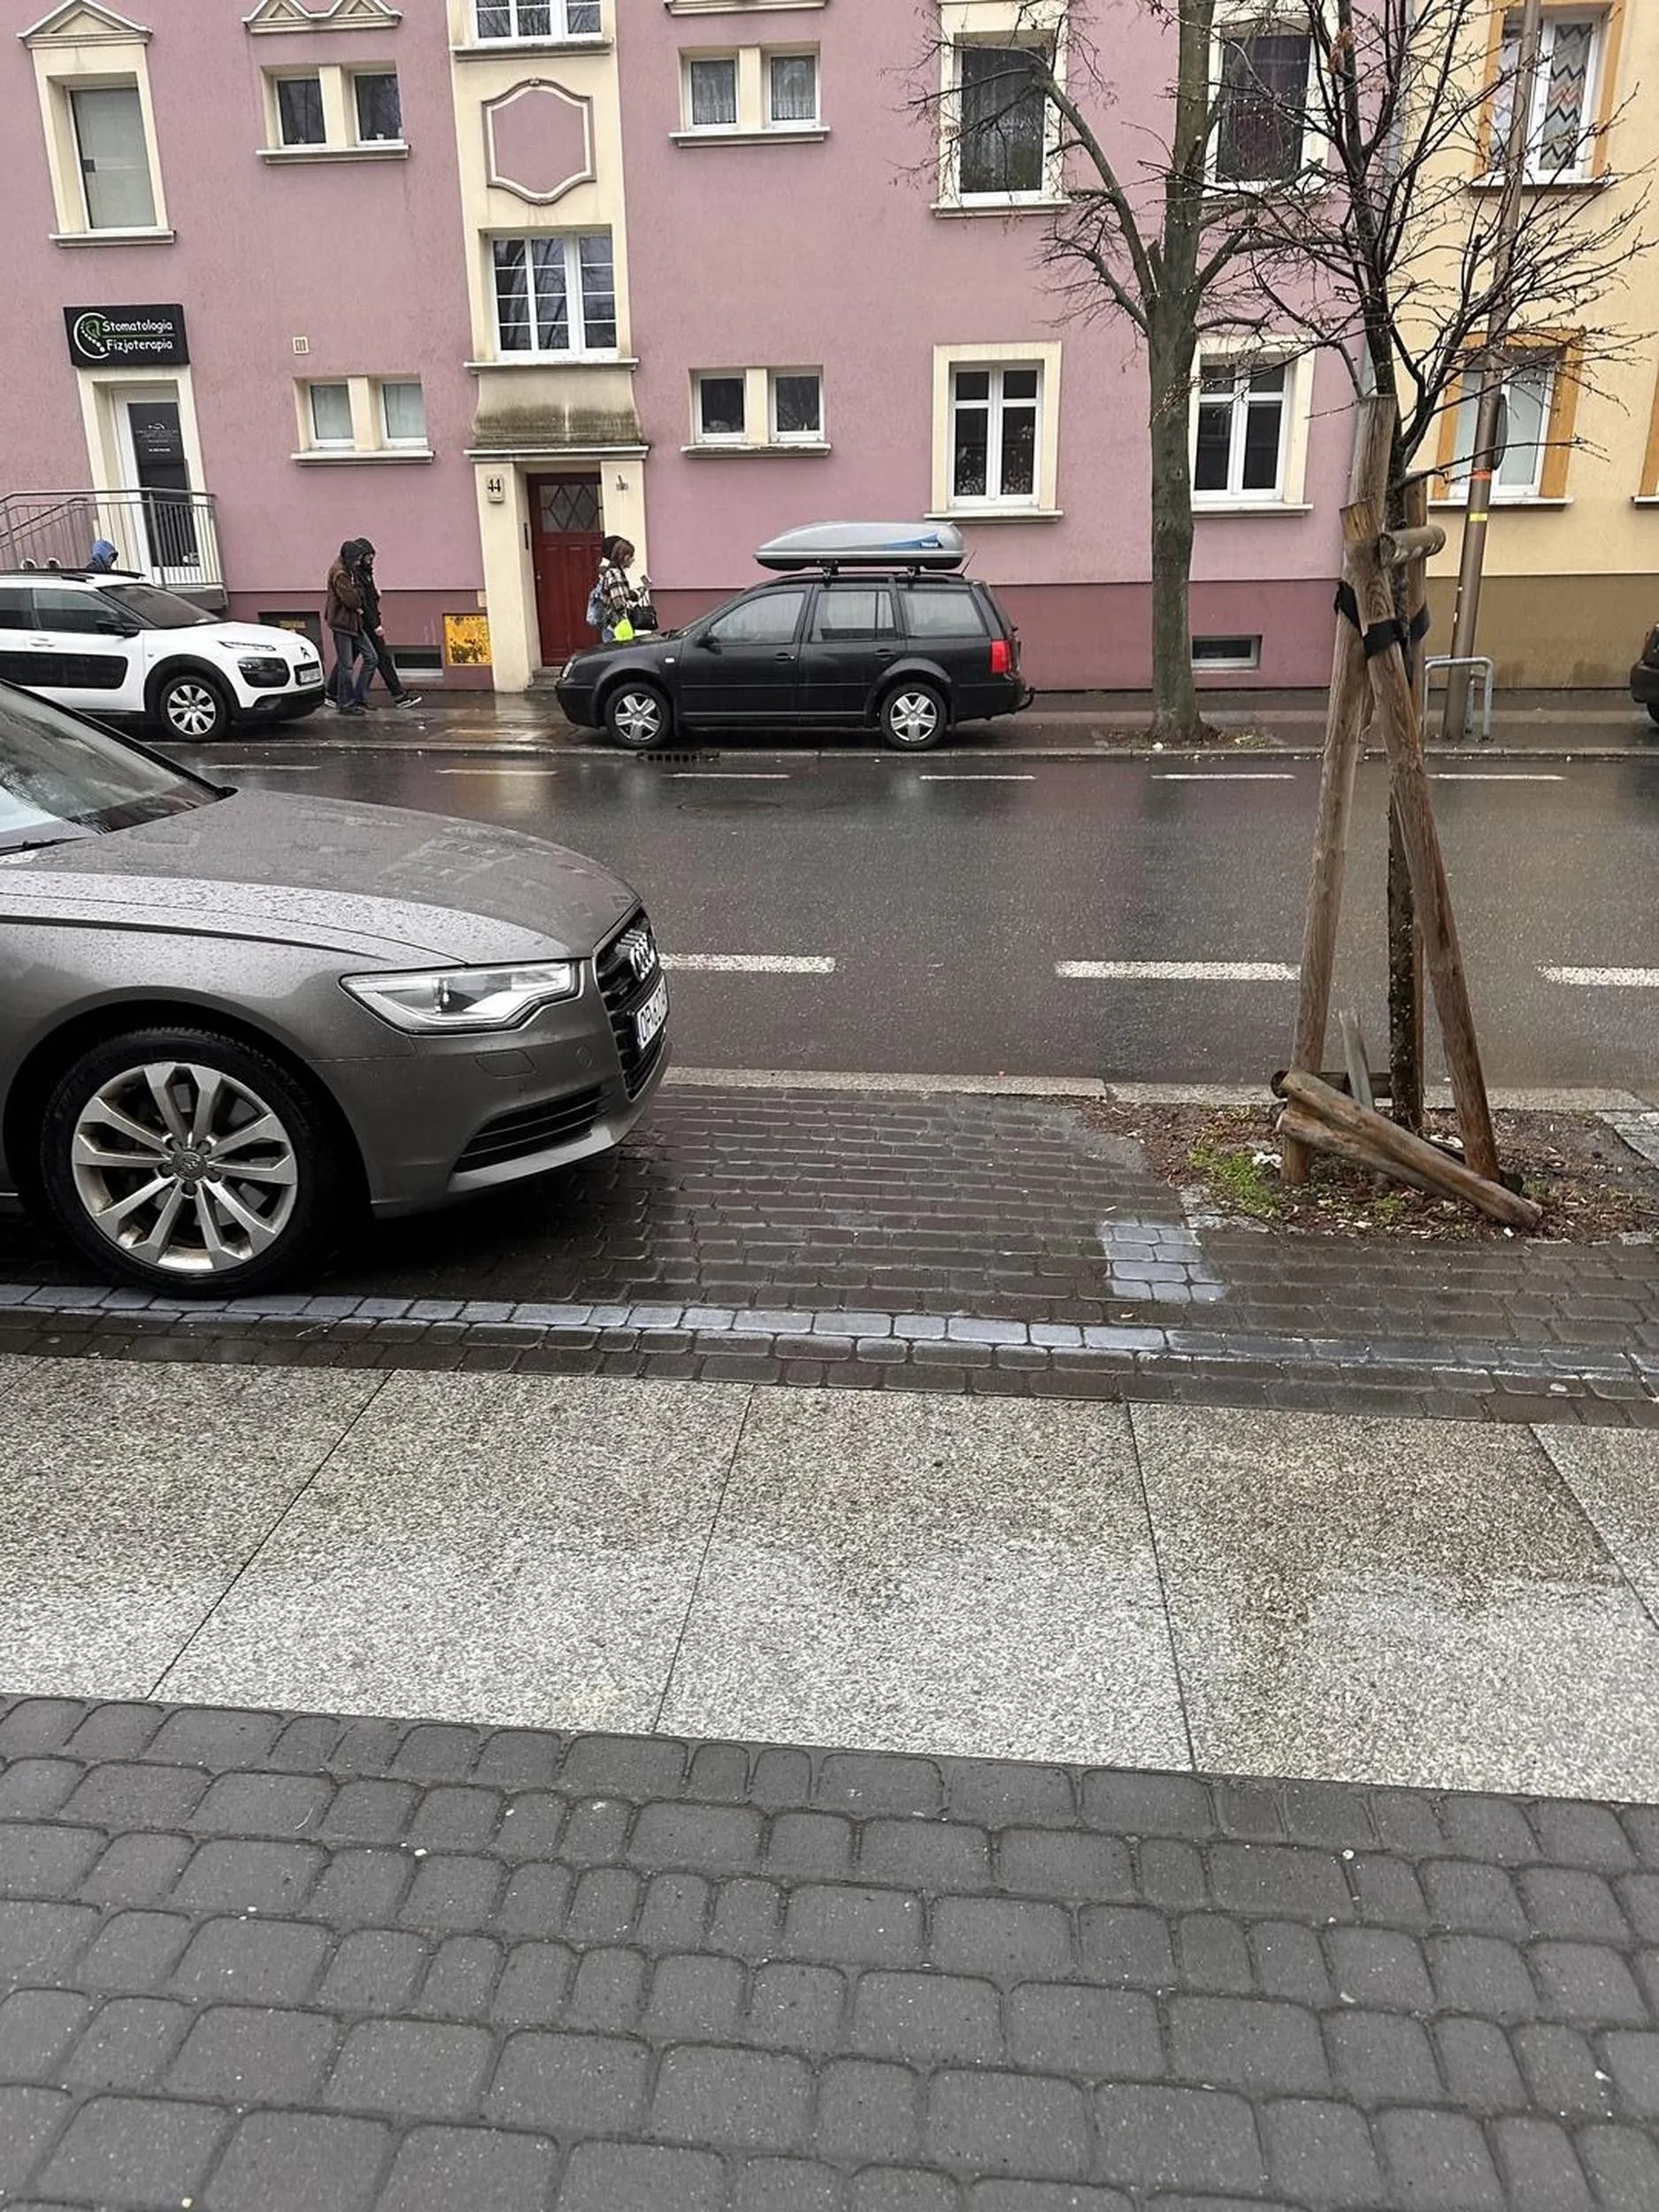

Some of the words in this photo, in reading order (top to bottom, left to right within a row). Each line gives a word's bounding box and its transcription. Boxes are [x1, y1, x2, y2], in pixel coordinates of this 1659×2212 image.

[102, 319, 173, 334] Stomatologia
[106, 338, 173, 353] Fizjoterapia
[488, 479, 501, 492] 44
